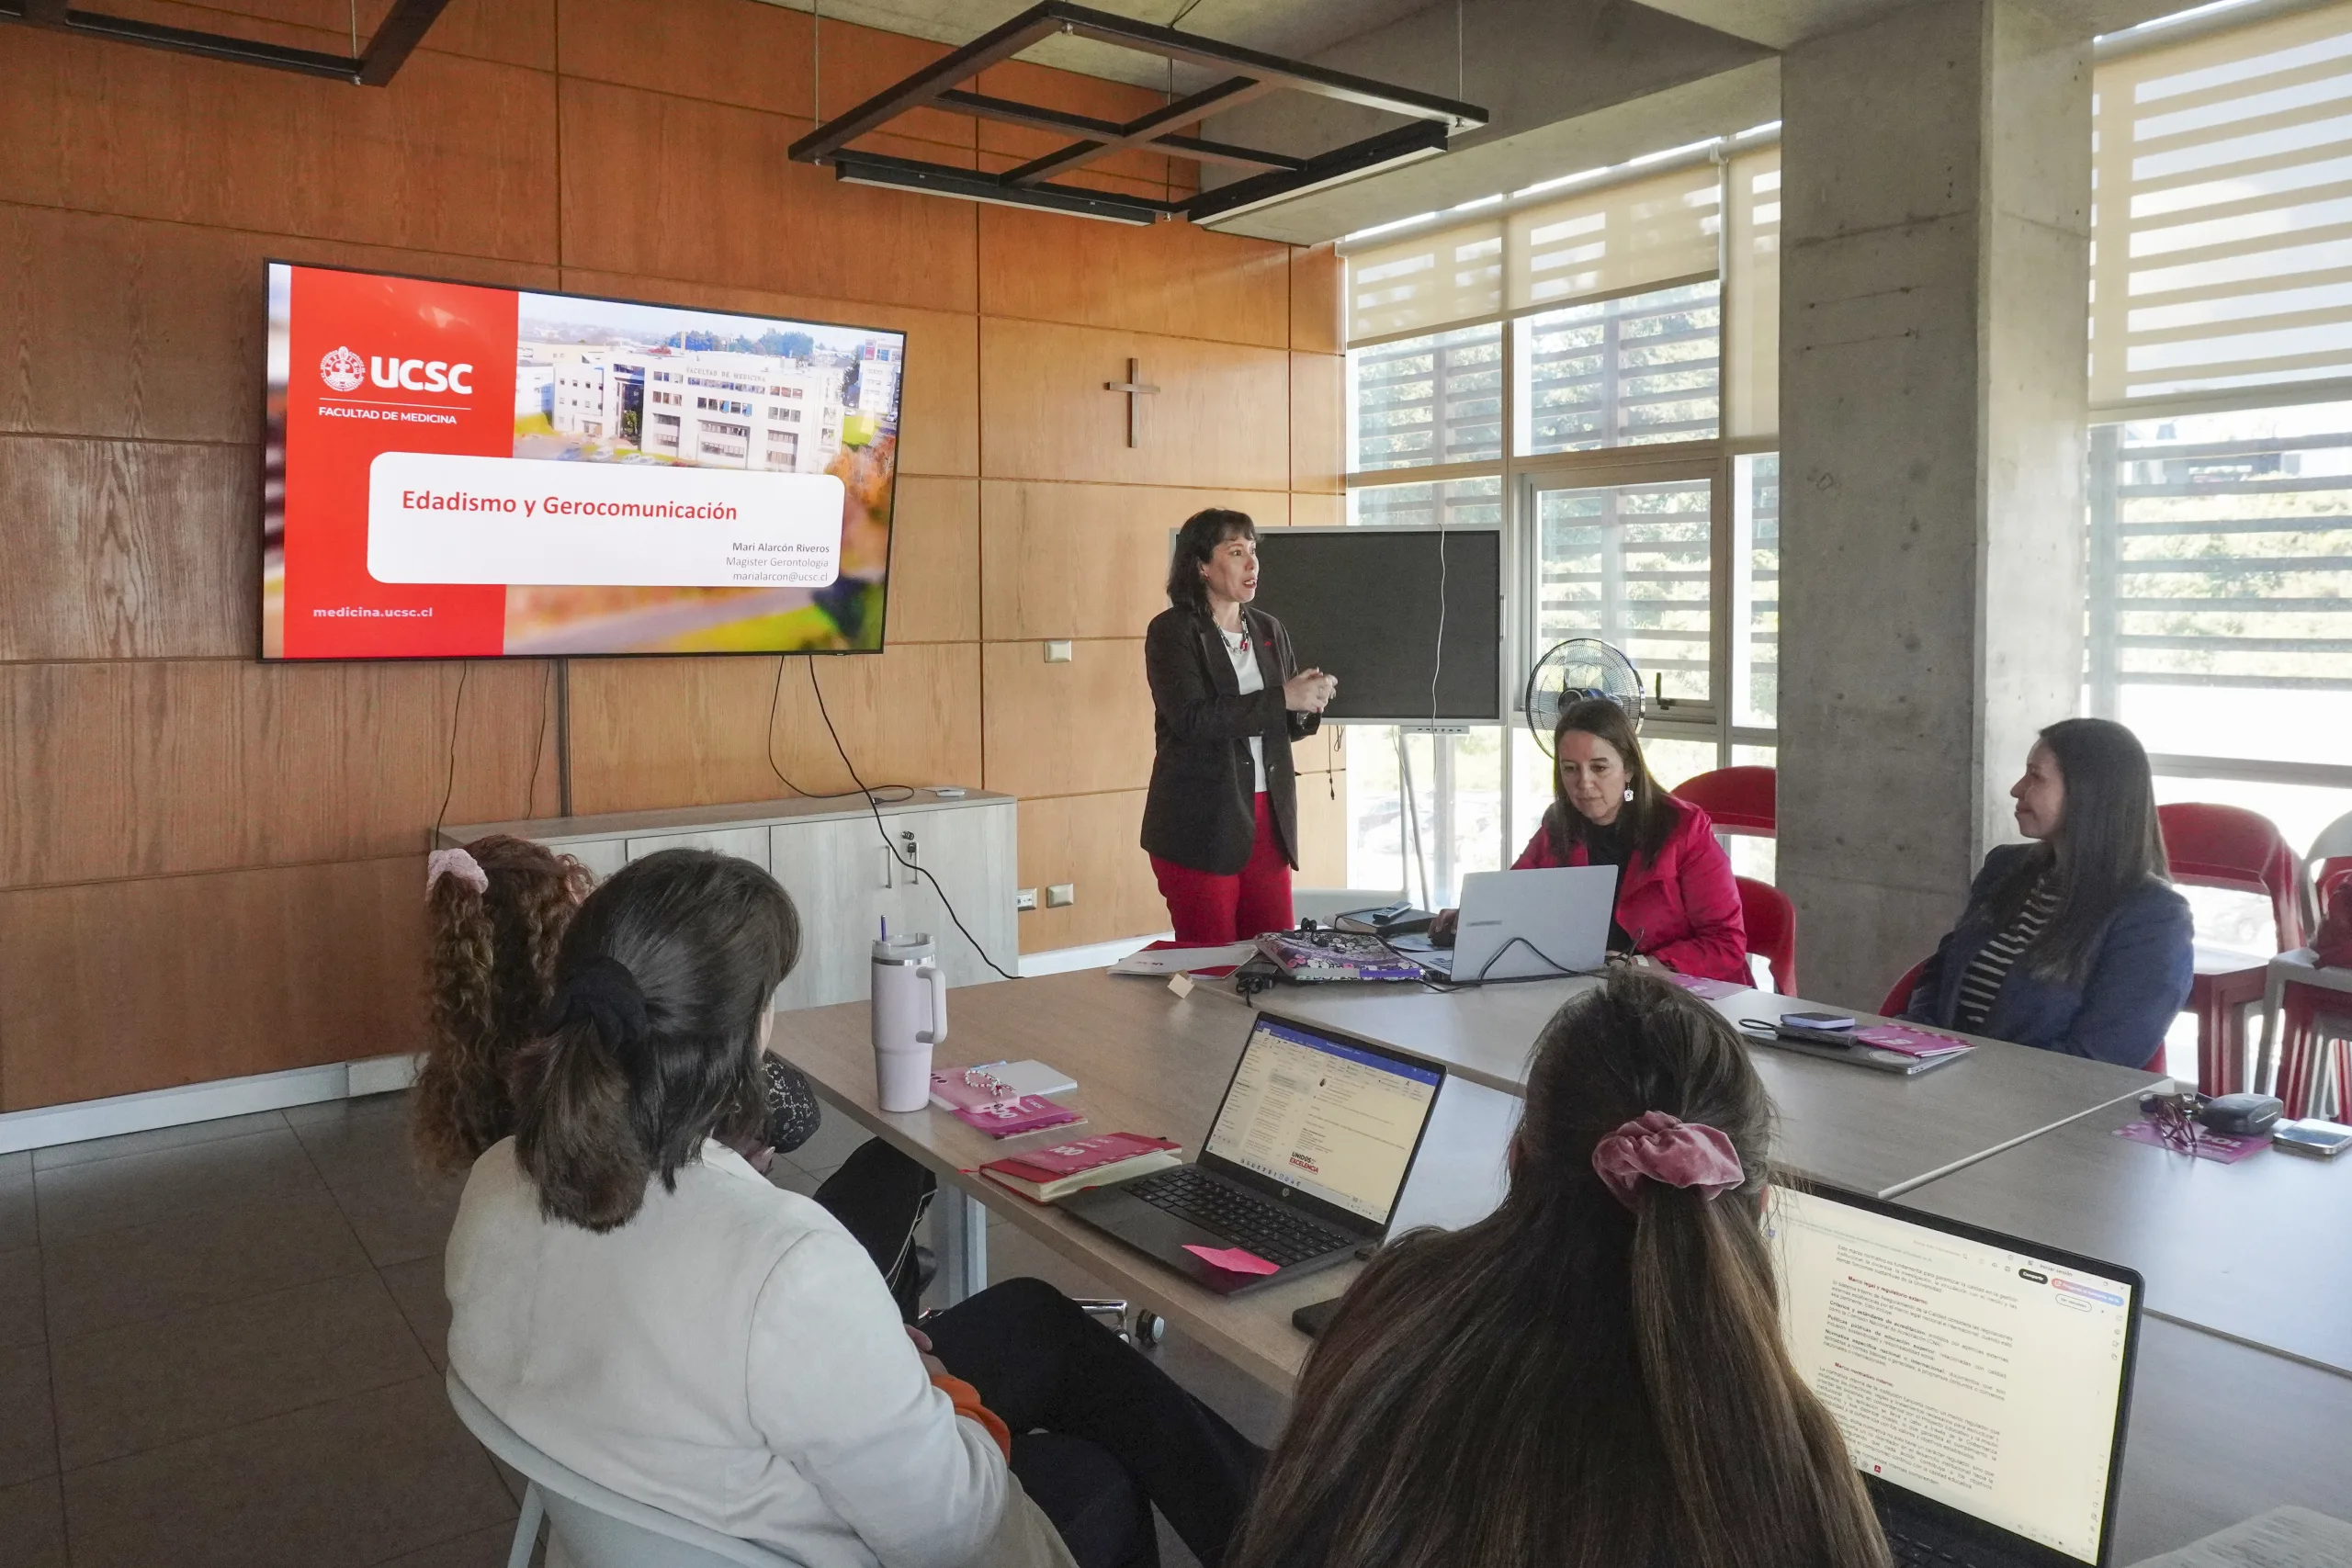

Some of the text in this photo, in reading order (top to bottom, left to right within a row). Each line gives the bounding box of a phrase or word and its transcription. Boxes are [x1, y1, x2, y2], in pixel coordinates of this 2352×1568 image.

[370, 355, 473, 395] UCSC
[318, 406, 458, 424] FACULTAD DE MEDICINA
[402, 490, 737, 521] Edadismo y Gerocomunicación
[732, 542, 830, 553] Mari Alarcón Riveros
[726, 557, 767, 568] Magister
[733, 571, 828, 582] marialarcon@ucsc.cl
[313, 606, 433, 617] medicina.ucsc.cl
[1291, 1151, 1311, 1163] UNIDOS
[1288, 1156, 1319, 1173] EXCELENCIA
